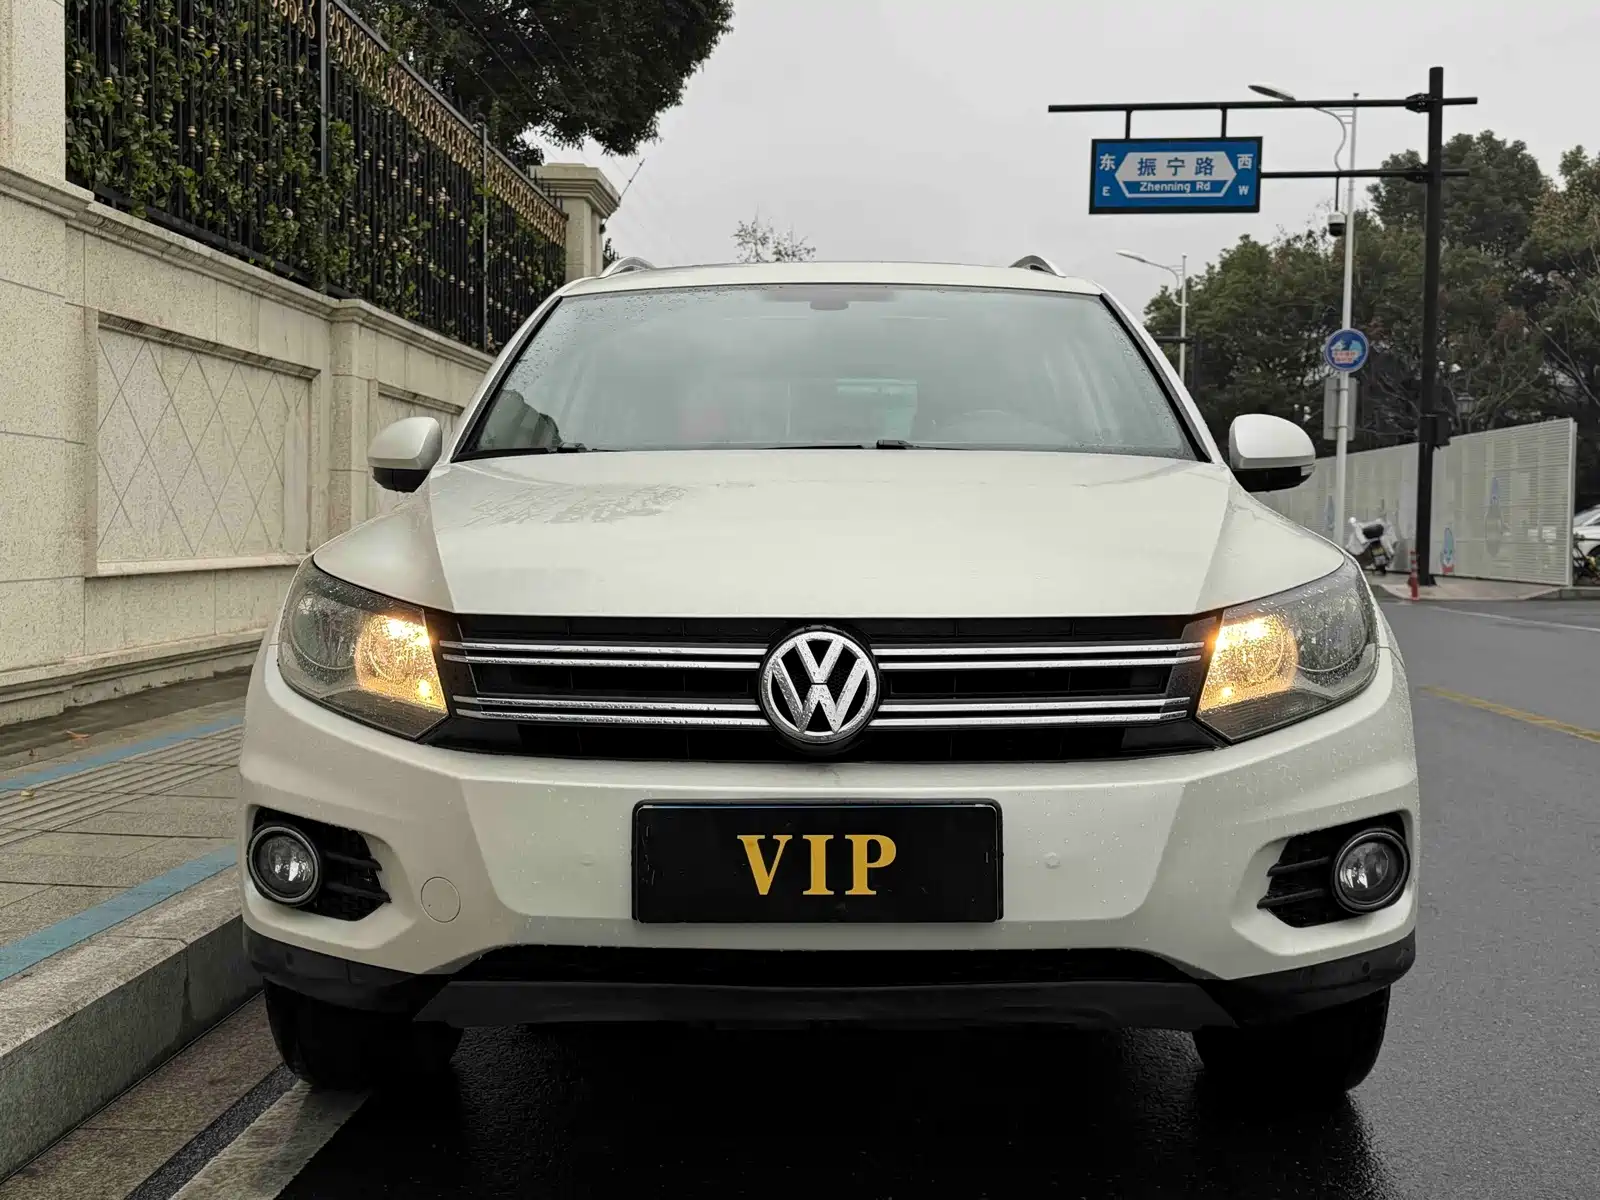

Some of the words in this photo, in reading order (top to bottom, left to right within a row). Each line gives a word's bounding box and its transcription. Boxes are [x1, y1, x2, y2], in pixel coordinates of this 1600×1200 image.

[1099, 153, 1116, 171] 东
[1137, 157, 1215, 177] 振宁路
[1237, 153, 1254, 170] 西
[1102, 186, 1111, 197] E
[1139, 181, 1191, 194] Zhenning
[1195, 181, 1211, 192] Rd
[1238, 185, 1250, 196] W
[762, 631, 877, 742] VW
[737, 834, 897, 896] VIP
